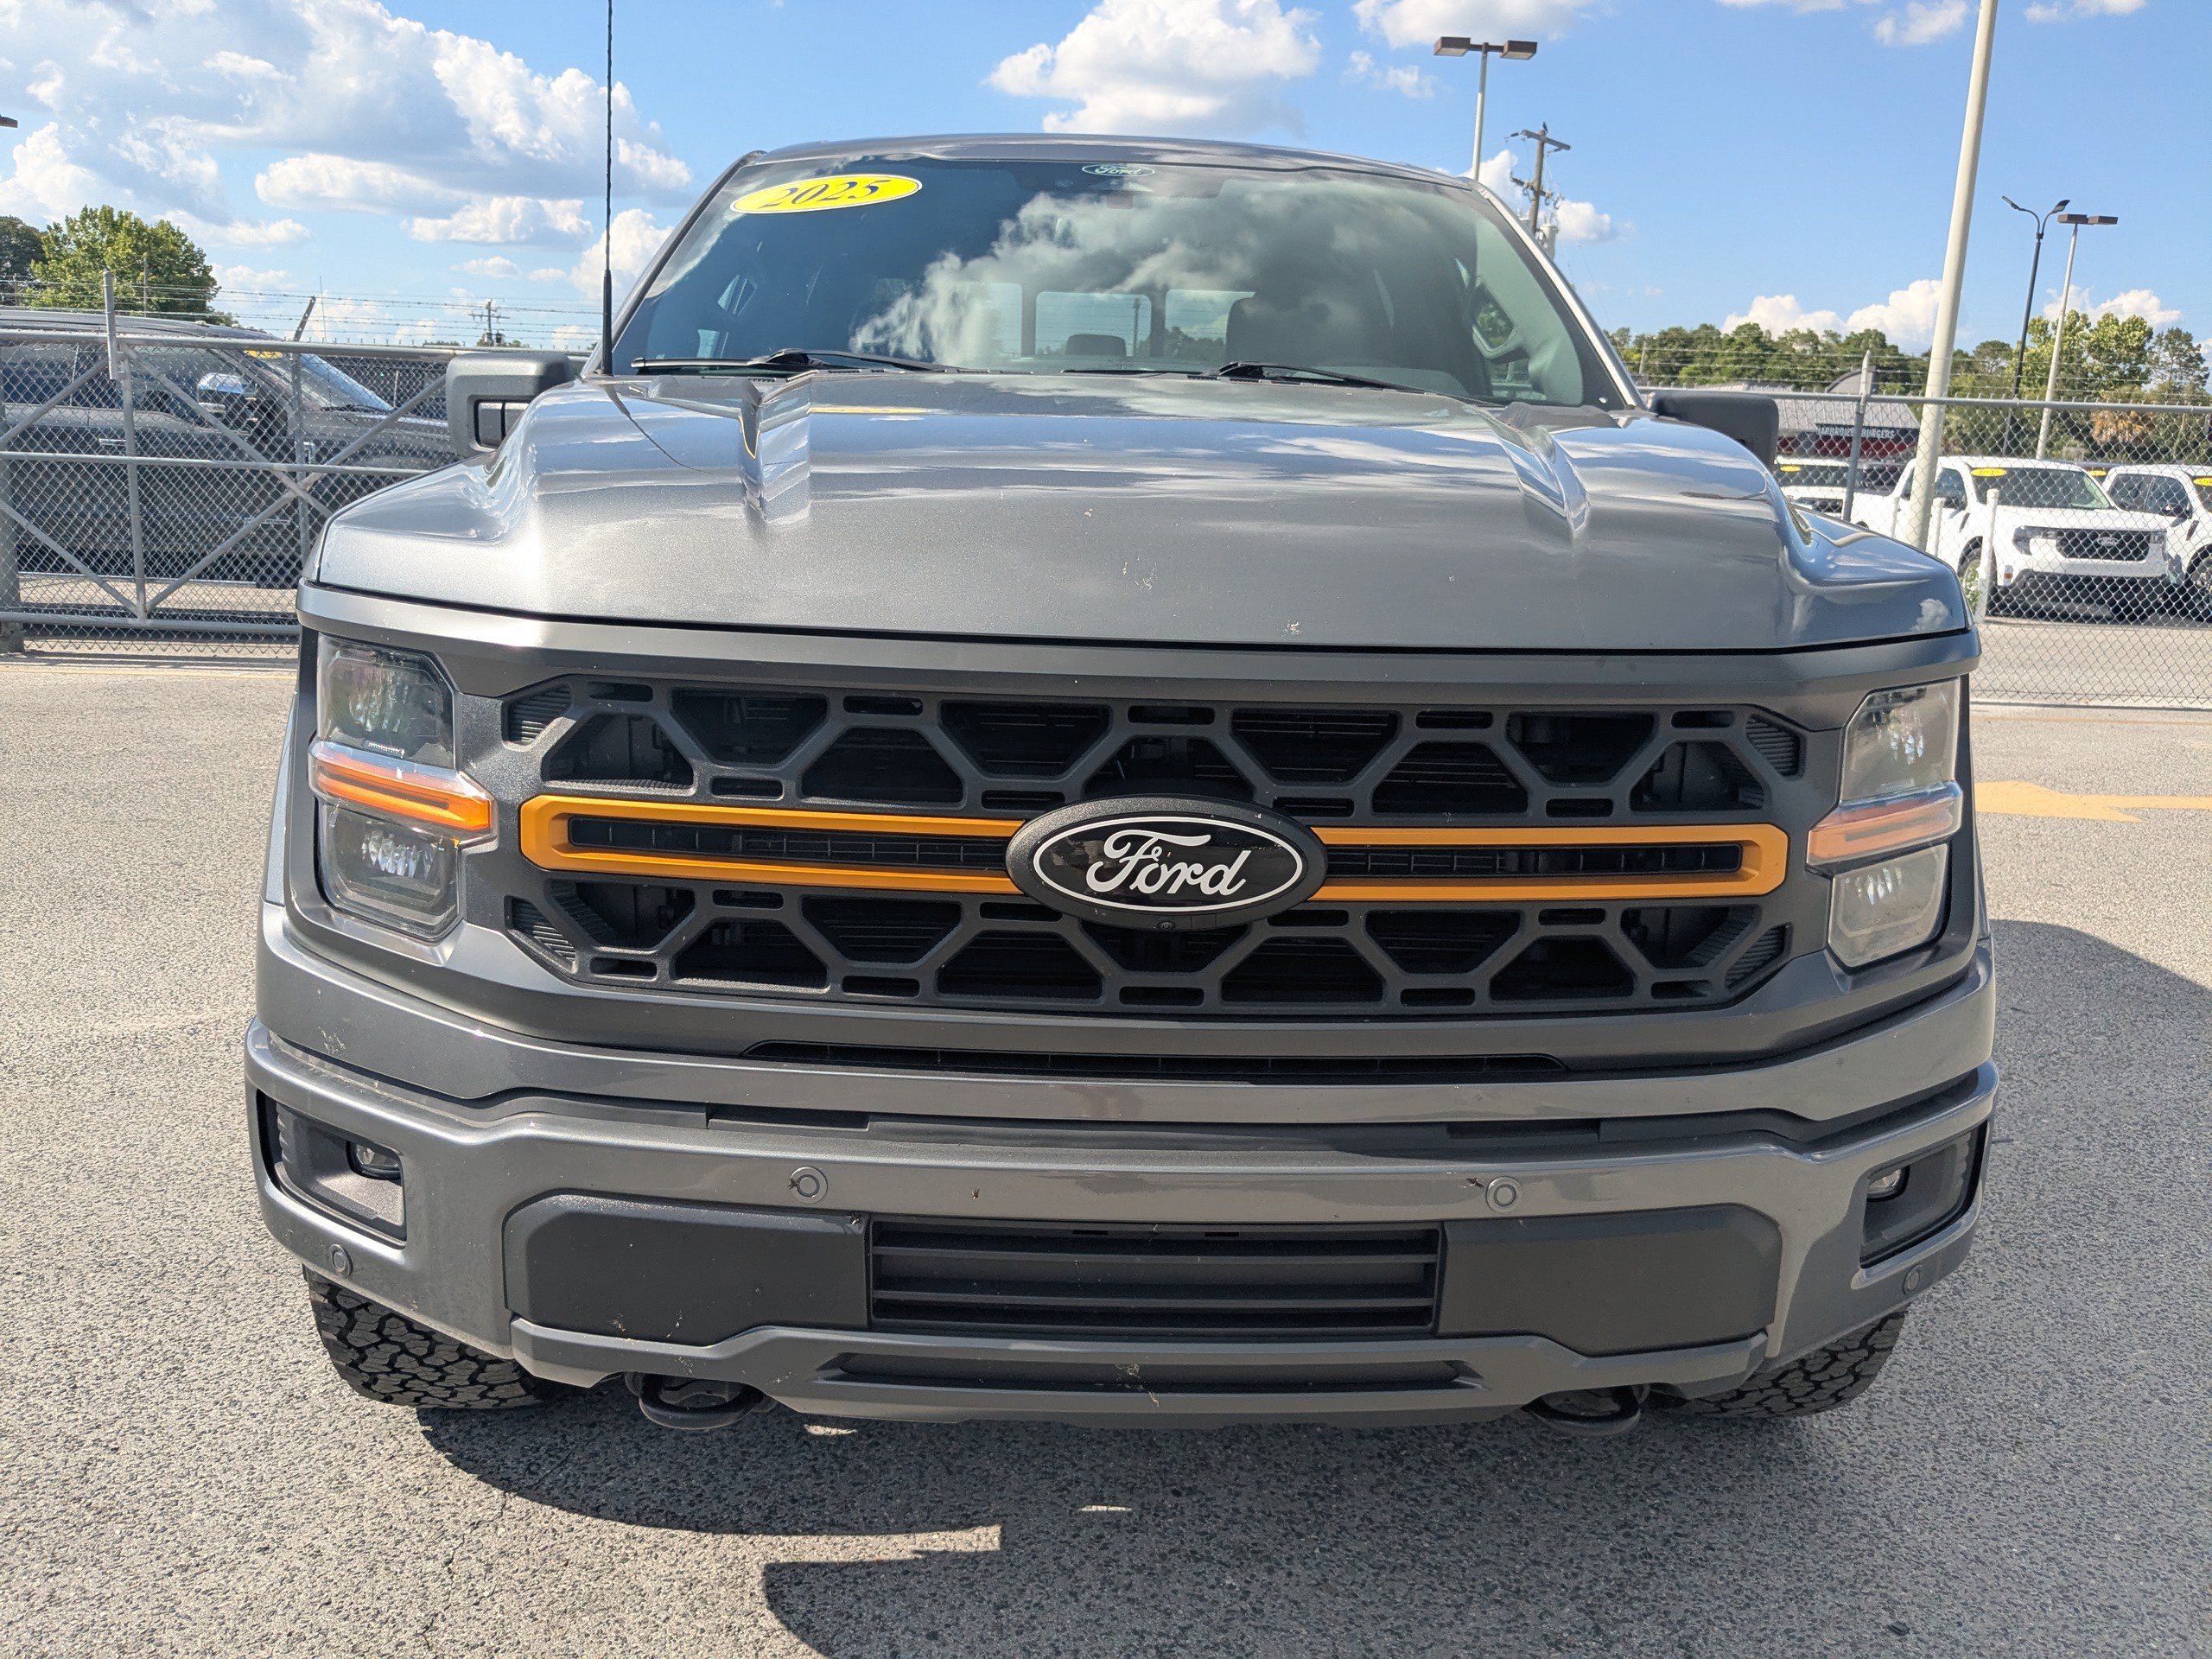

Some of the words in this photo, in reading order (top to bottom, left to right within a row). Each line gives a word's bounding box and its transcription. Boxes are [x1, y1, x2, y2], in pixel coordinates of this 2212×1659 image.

[1094, 165, 1142, 175] Ford
[757, 180, 893, 209] 2025
[1861, 428, 1895, 439] BURGERS
[1086, 830, 1252, 895] Ford
